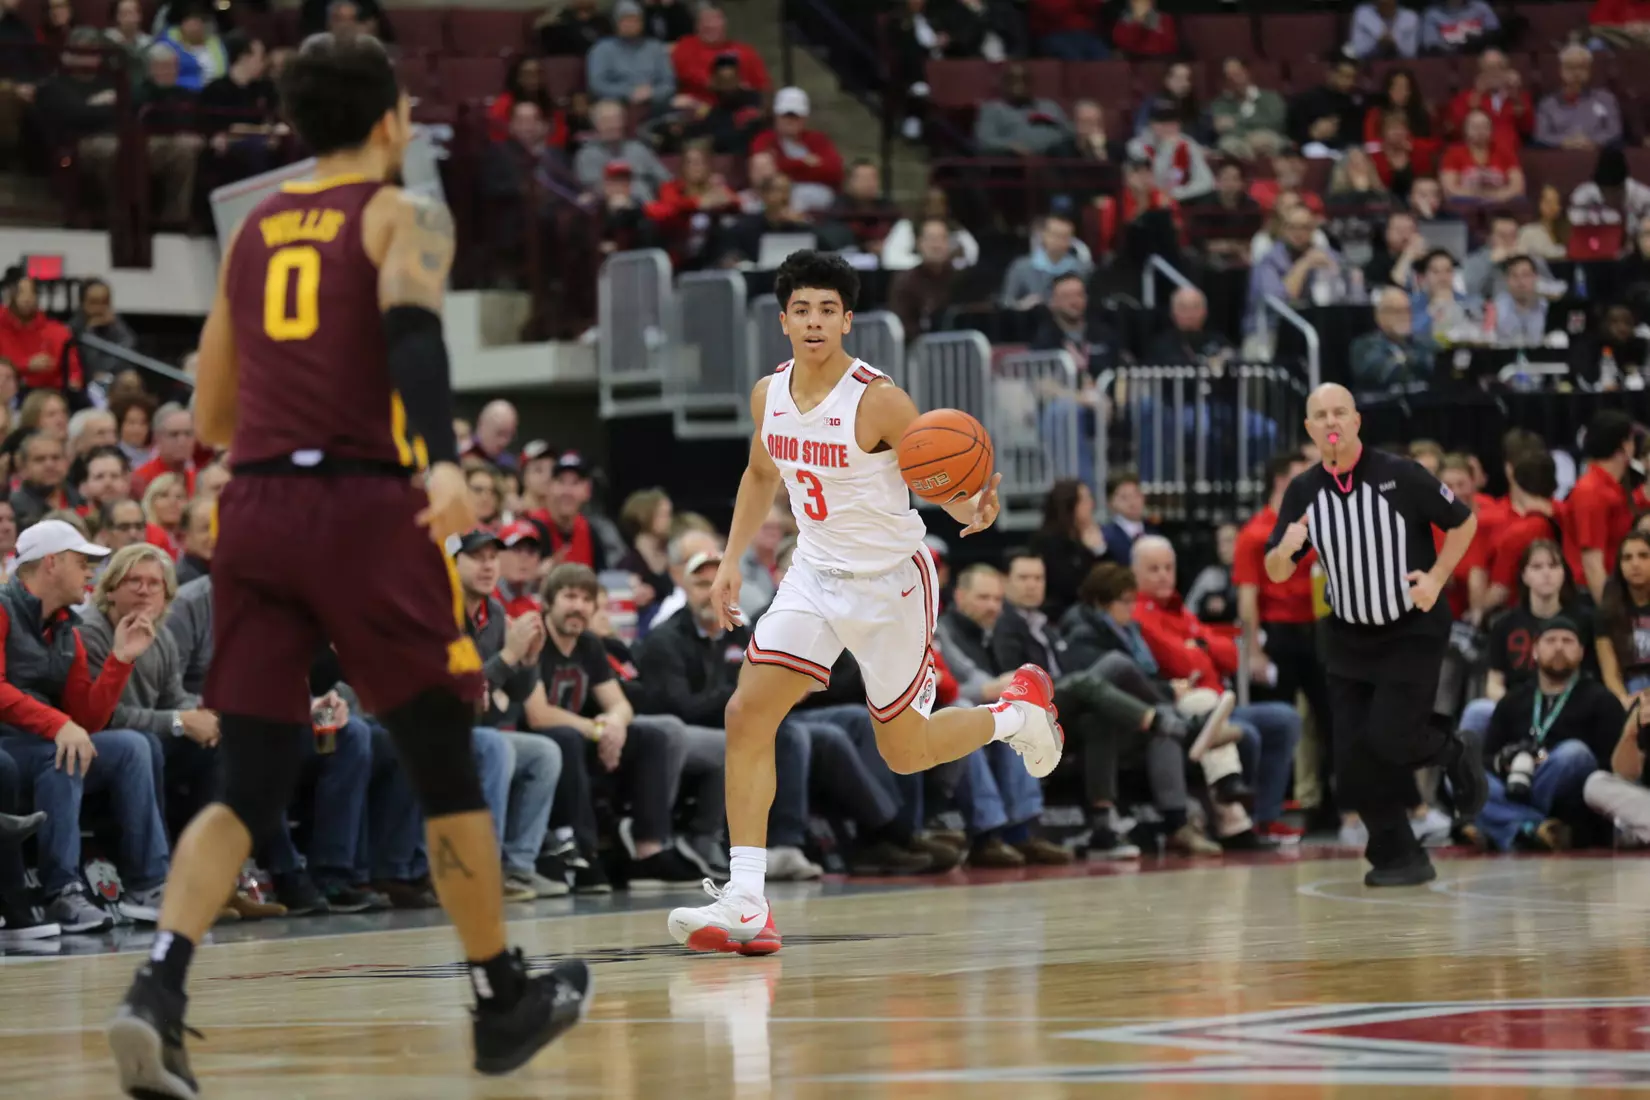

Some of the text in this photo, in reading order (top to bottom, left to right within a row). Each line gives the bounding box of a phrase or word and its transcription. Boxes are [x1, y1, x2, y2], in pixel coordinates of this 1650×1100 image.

[264, 246, 321, 342] 0
[767, 434, 849, 468] OHIO STATE
[796, 469, 828, 522] 3
